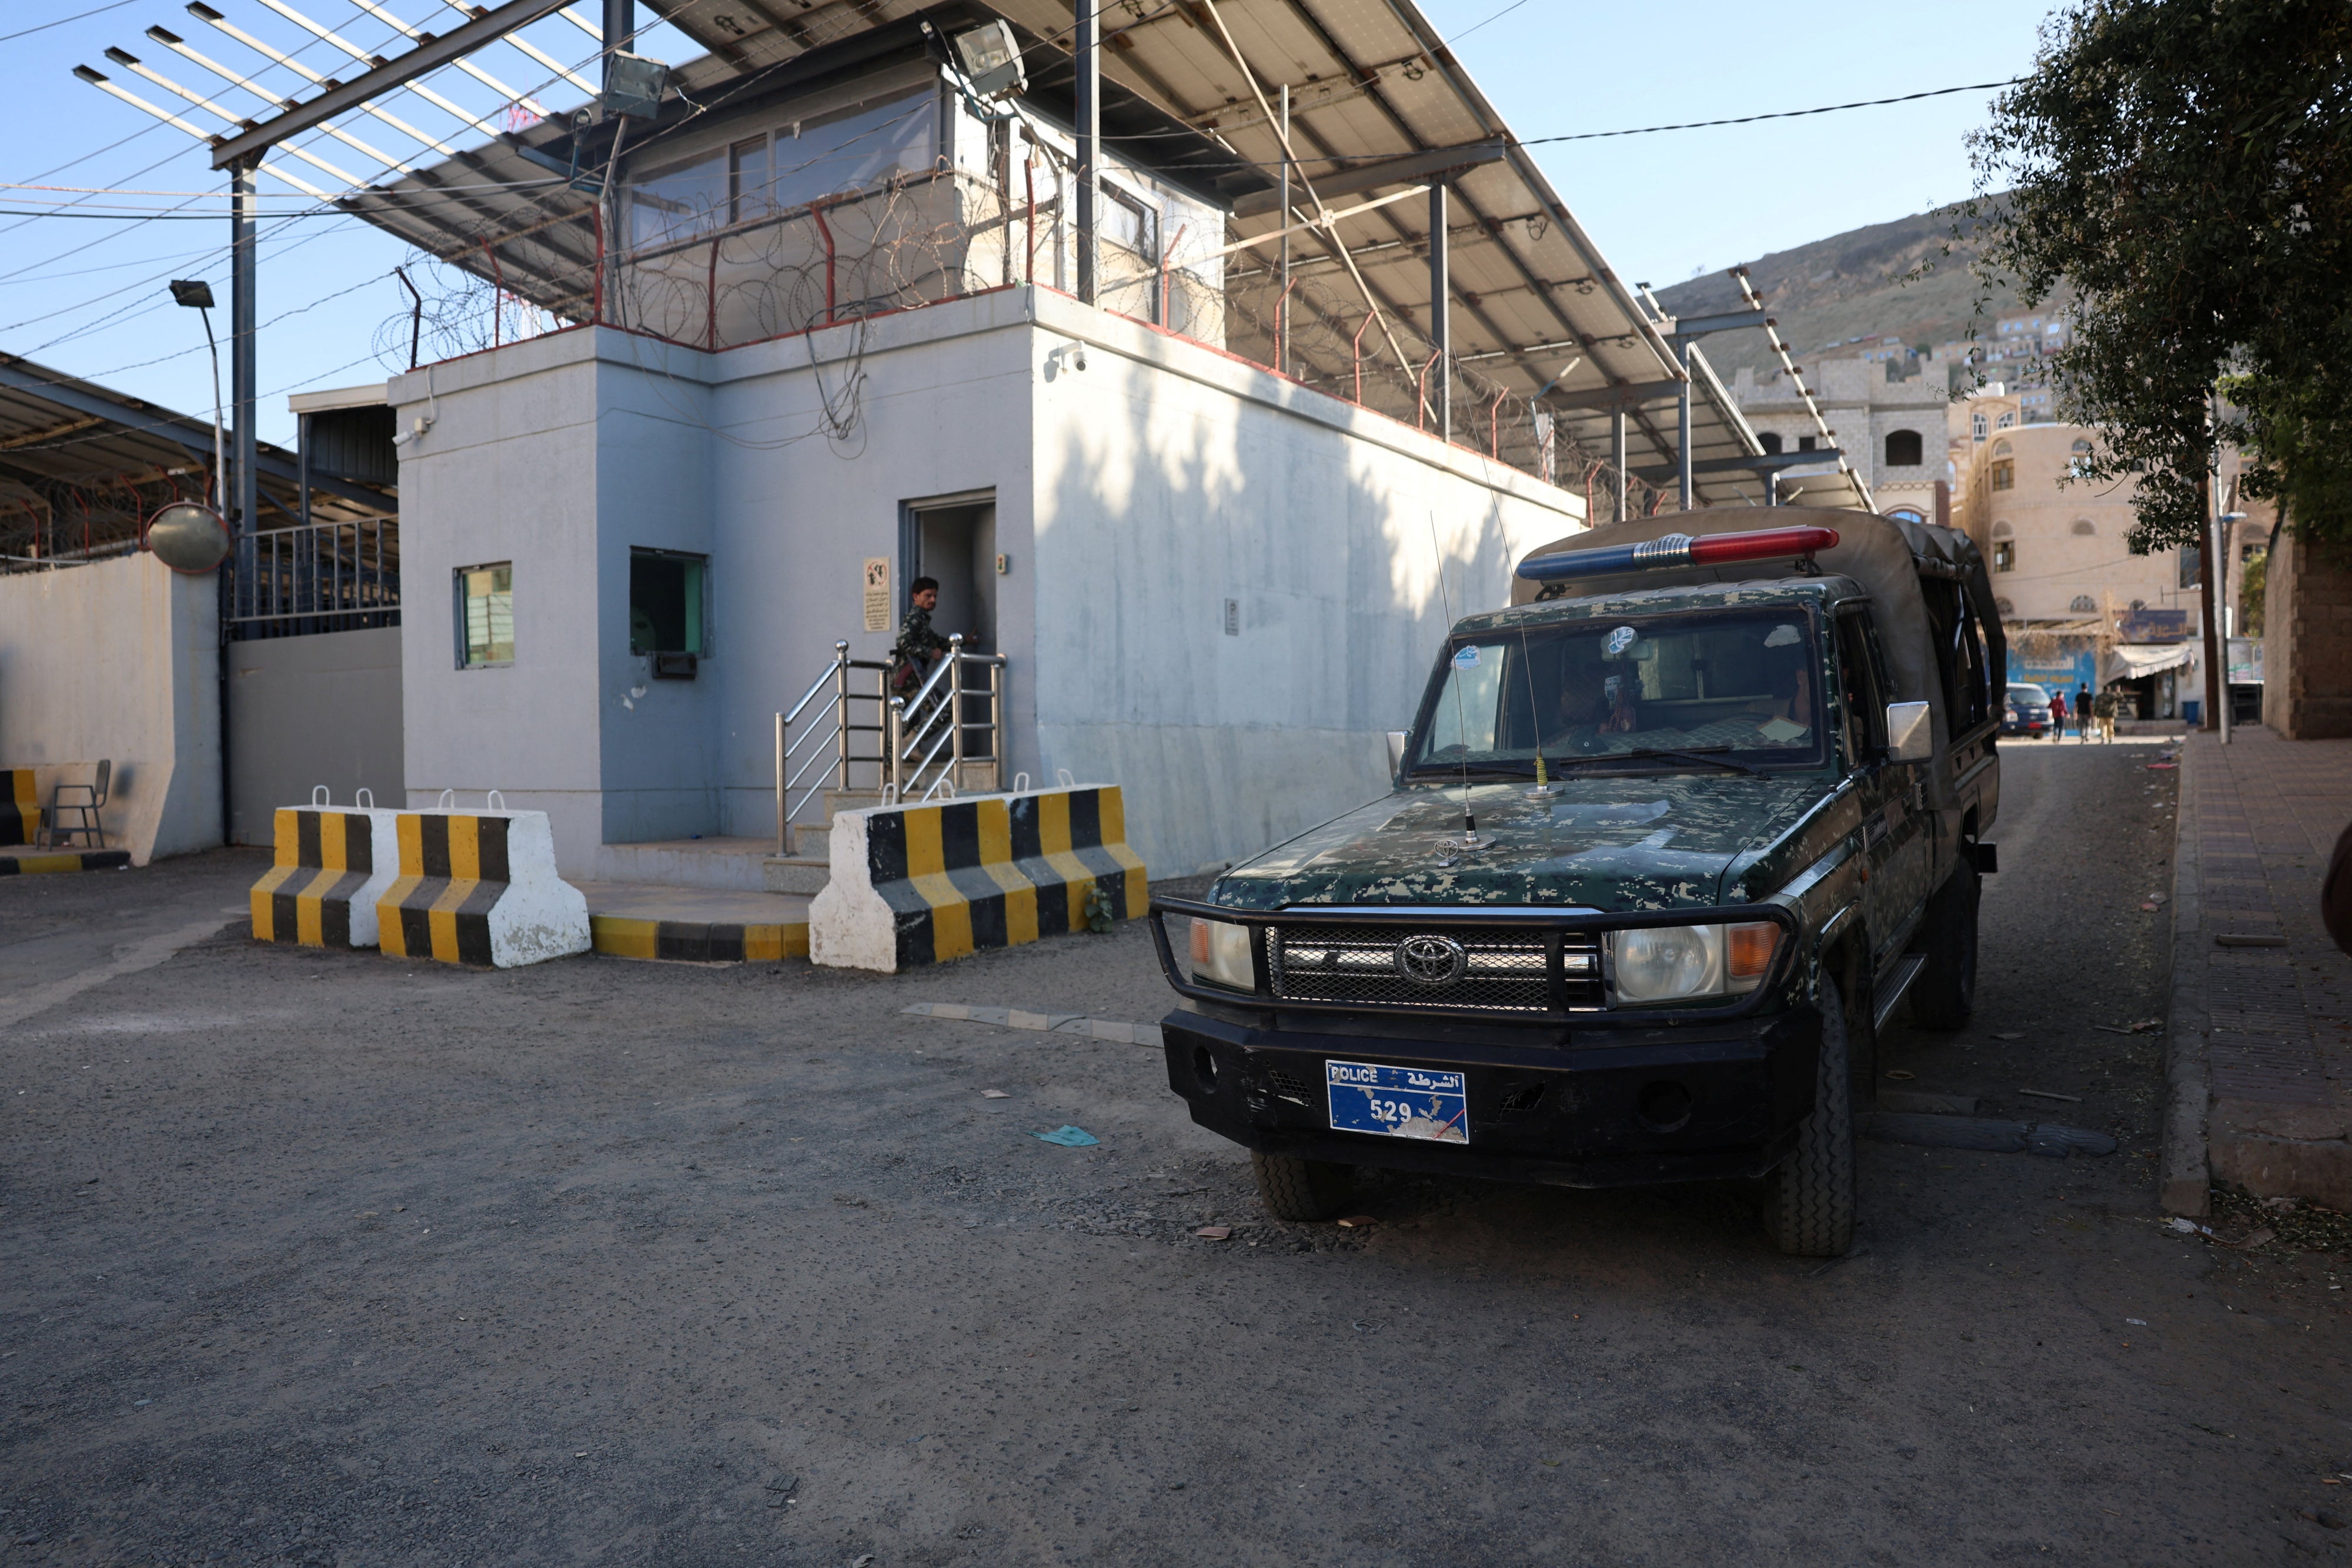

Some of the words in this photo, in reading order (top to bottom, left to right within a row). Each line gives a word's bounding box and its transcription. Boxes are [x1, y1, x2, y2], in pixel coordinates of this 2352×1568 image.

[1331, 1066, 1378, 1083] POLICE
[1407, 1072, 1459, 1089] الشرطة
[1371, 1099, 1411, 1123] 529
